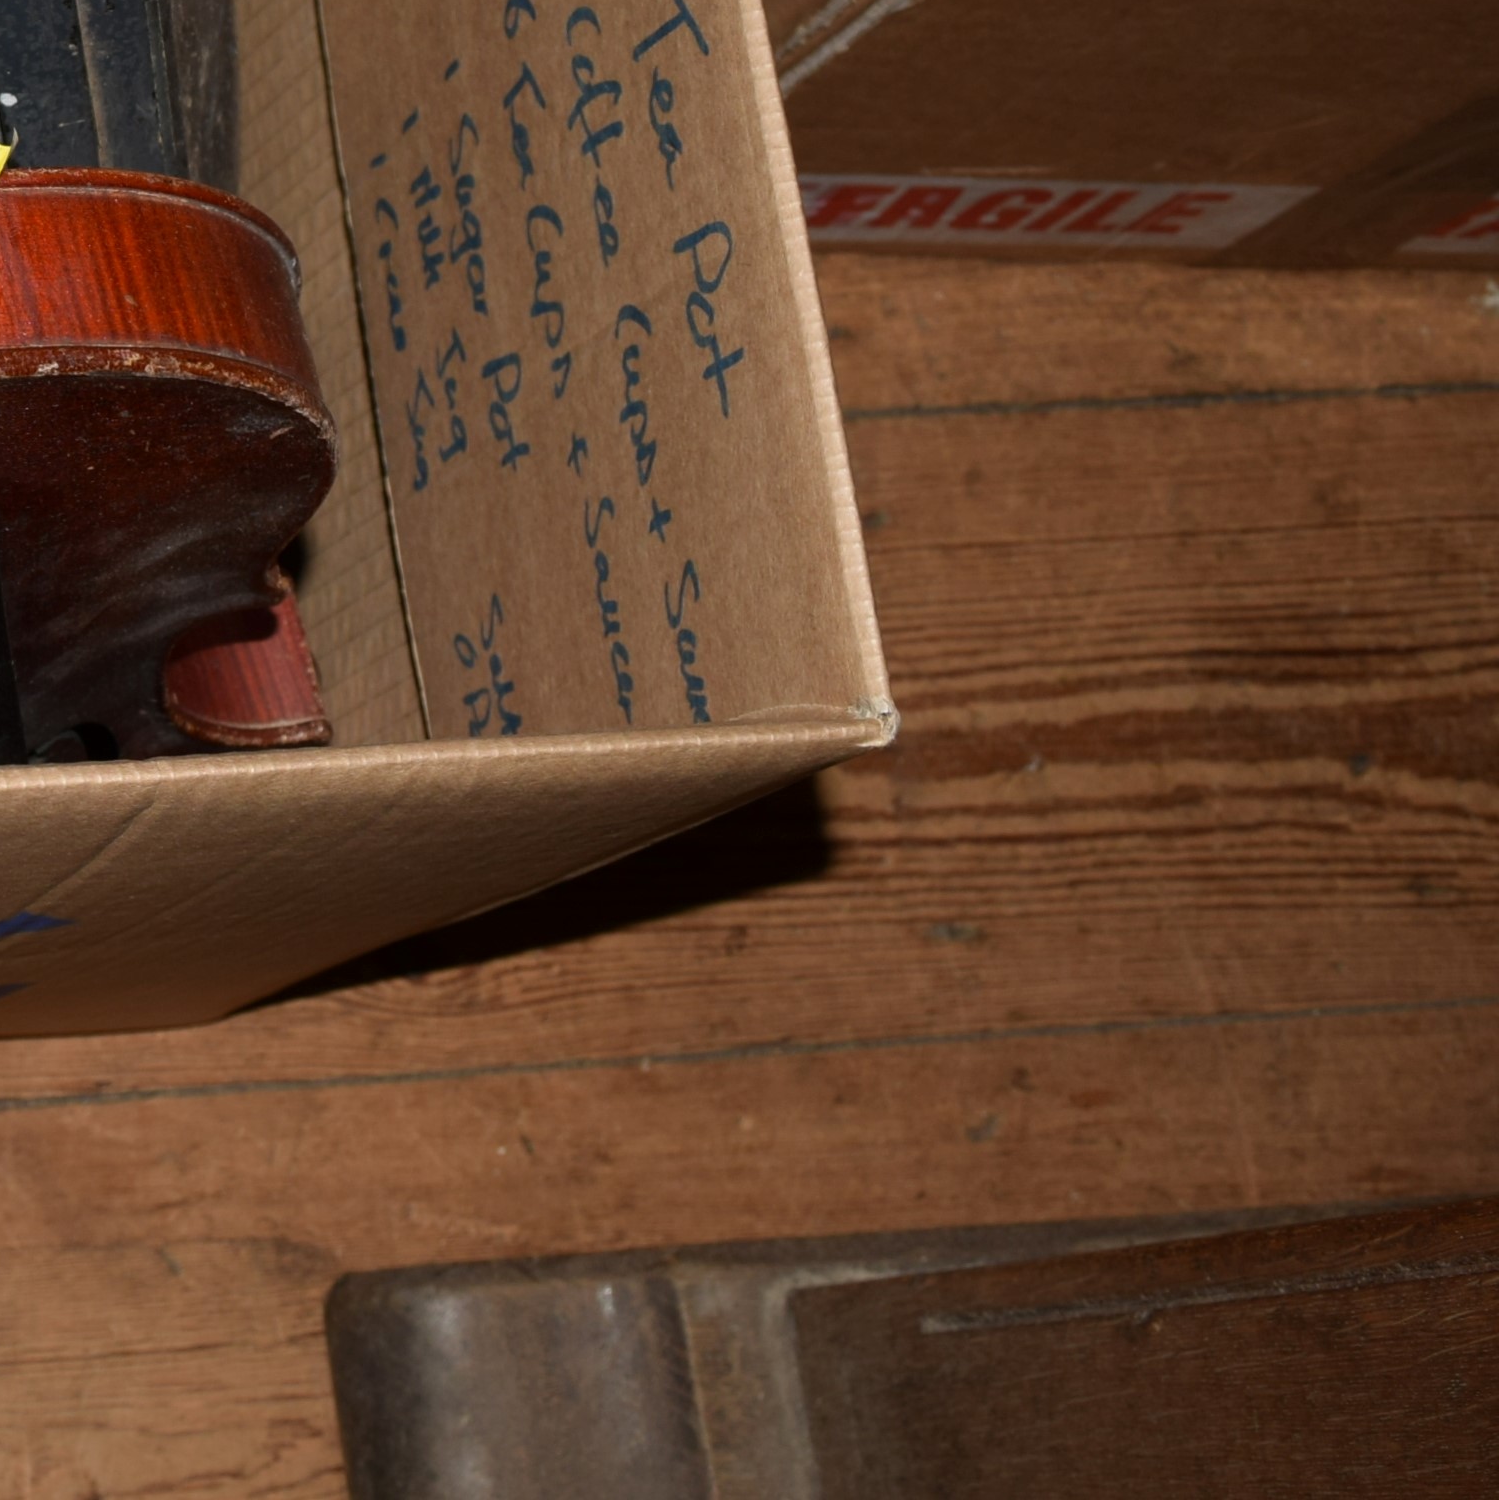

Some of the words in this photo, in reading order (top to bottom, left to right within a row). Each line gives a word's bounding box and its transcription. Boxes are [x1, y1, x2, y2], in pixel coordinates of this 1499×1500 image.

[448, 111, 489, 317] Sugar
[481, 351, 531, 472] Pot
[504, 61, 547, 192] Tea
[526, 204, 572, 399] Cups
[673, 220, 745, 419] Pot
[434, 326, 468, 463] Jug
[614, 304, 657, 486] Cups
